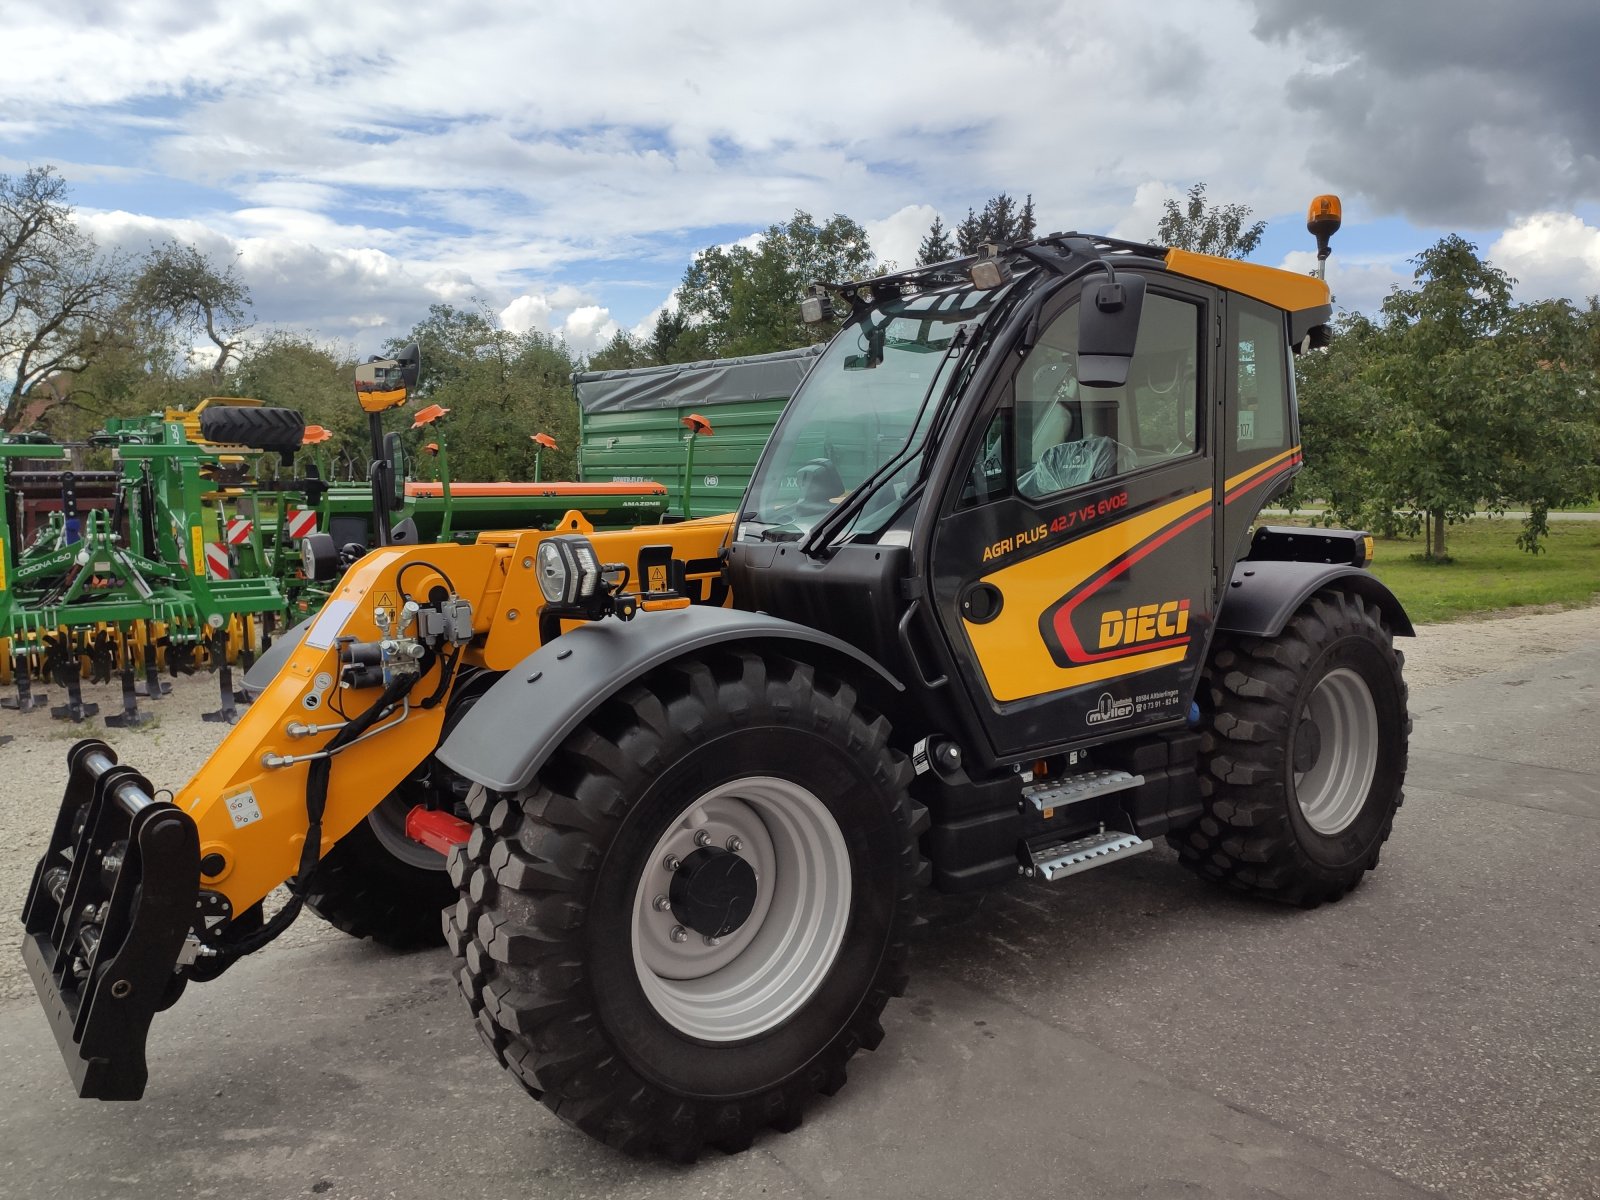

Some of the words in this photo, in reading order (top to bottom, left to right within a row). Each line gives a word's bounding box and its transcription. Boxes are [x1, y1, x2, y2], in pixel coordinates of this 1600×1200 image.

[982, 537, 1013, 562] AGRI
[1016, 524, 1048, 548] PLUS
[1050, 512, 1077, 532] 42.7
[1078, 504, 1096, 522] VS
[1098, 492, 1128, 515] EVO2
[18, 560, 52, 577] CORONA
[1098, 598, 1190, 648] DIECI
